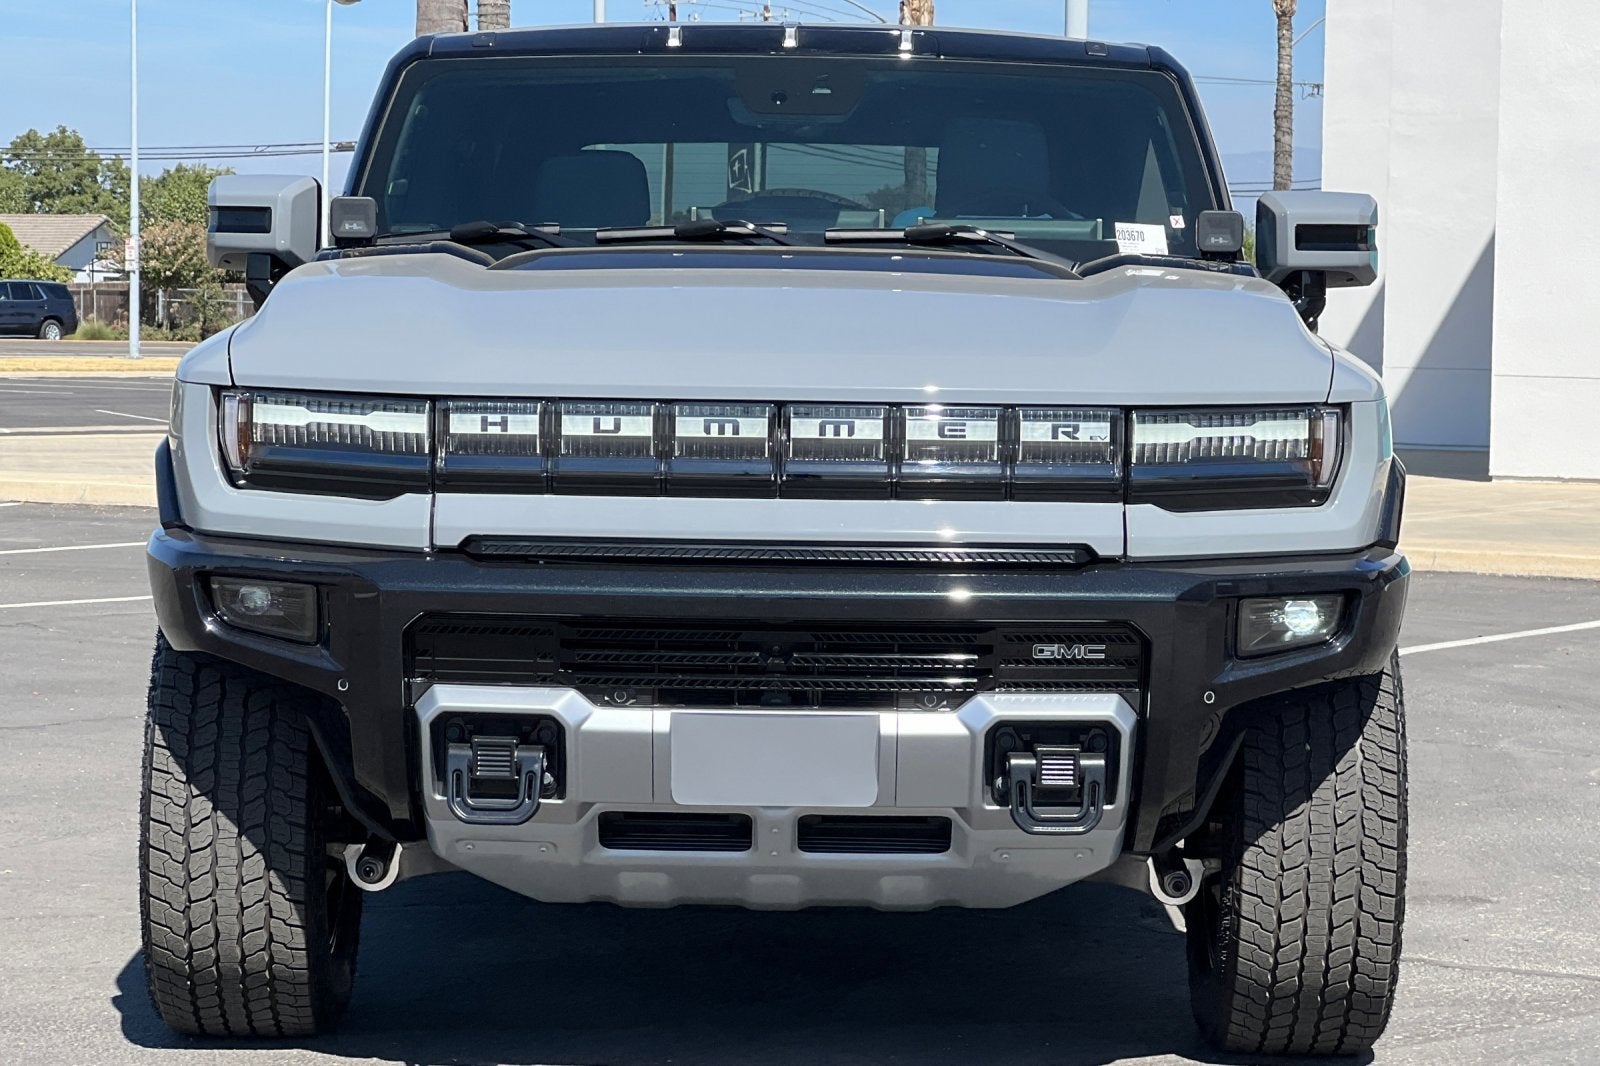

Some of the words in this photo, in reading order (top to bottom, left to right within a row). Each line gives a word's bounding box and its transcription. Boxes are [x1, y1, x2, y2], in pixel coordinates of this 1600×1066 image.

[1116, 229, 1145, 242] 203670
[480, 415, 1081, 441] HUMMER
[1032, 643, 1106, 659] GMC
